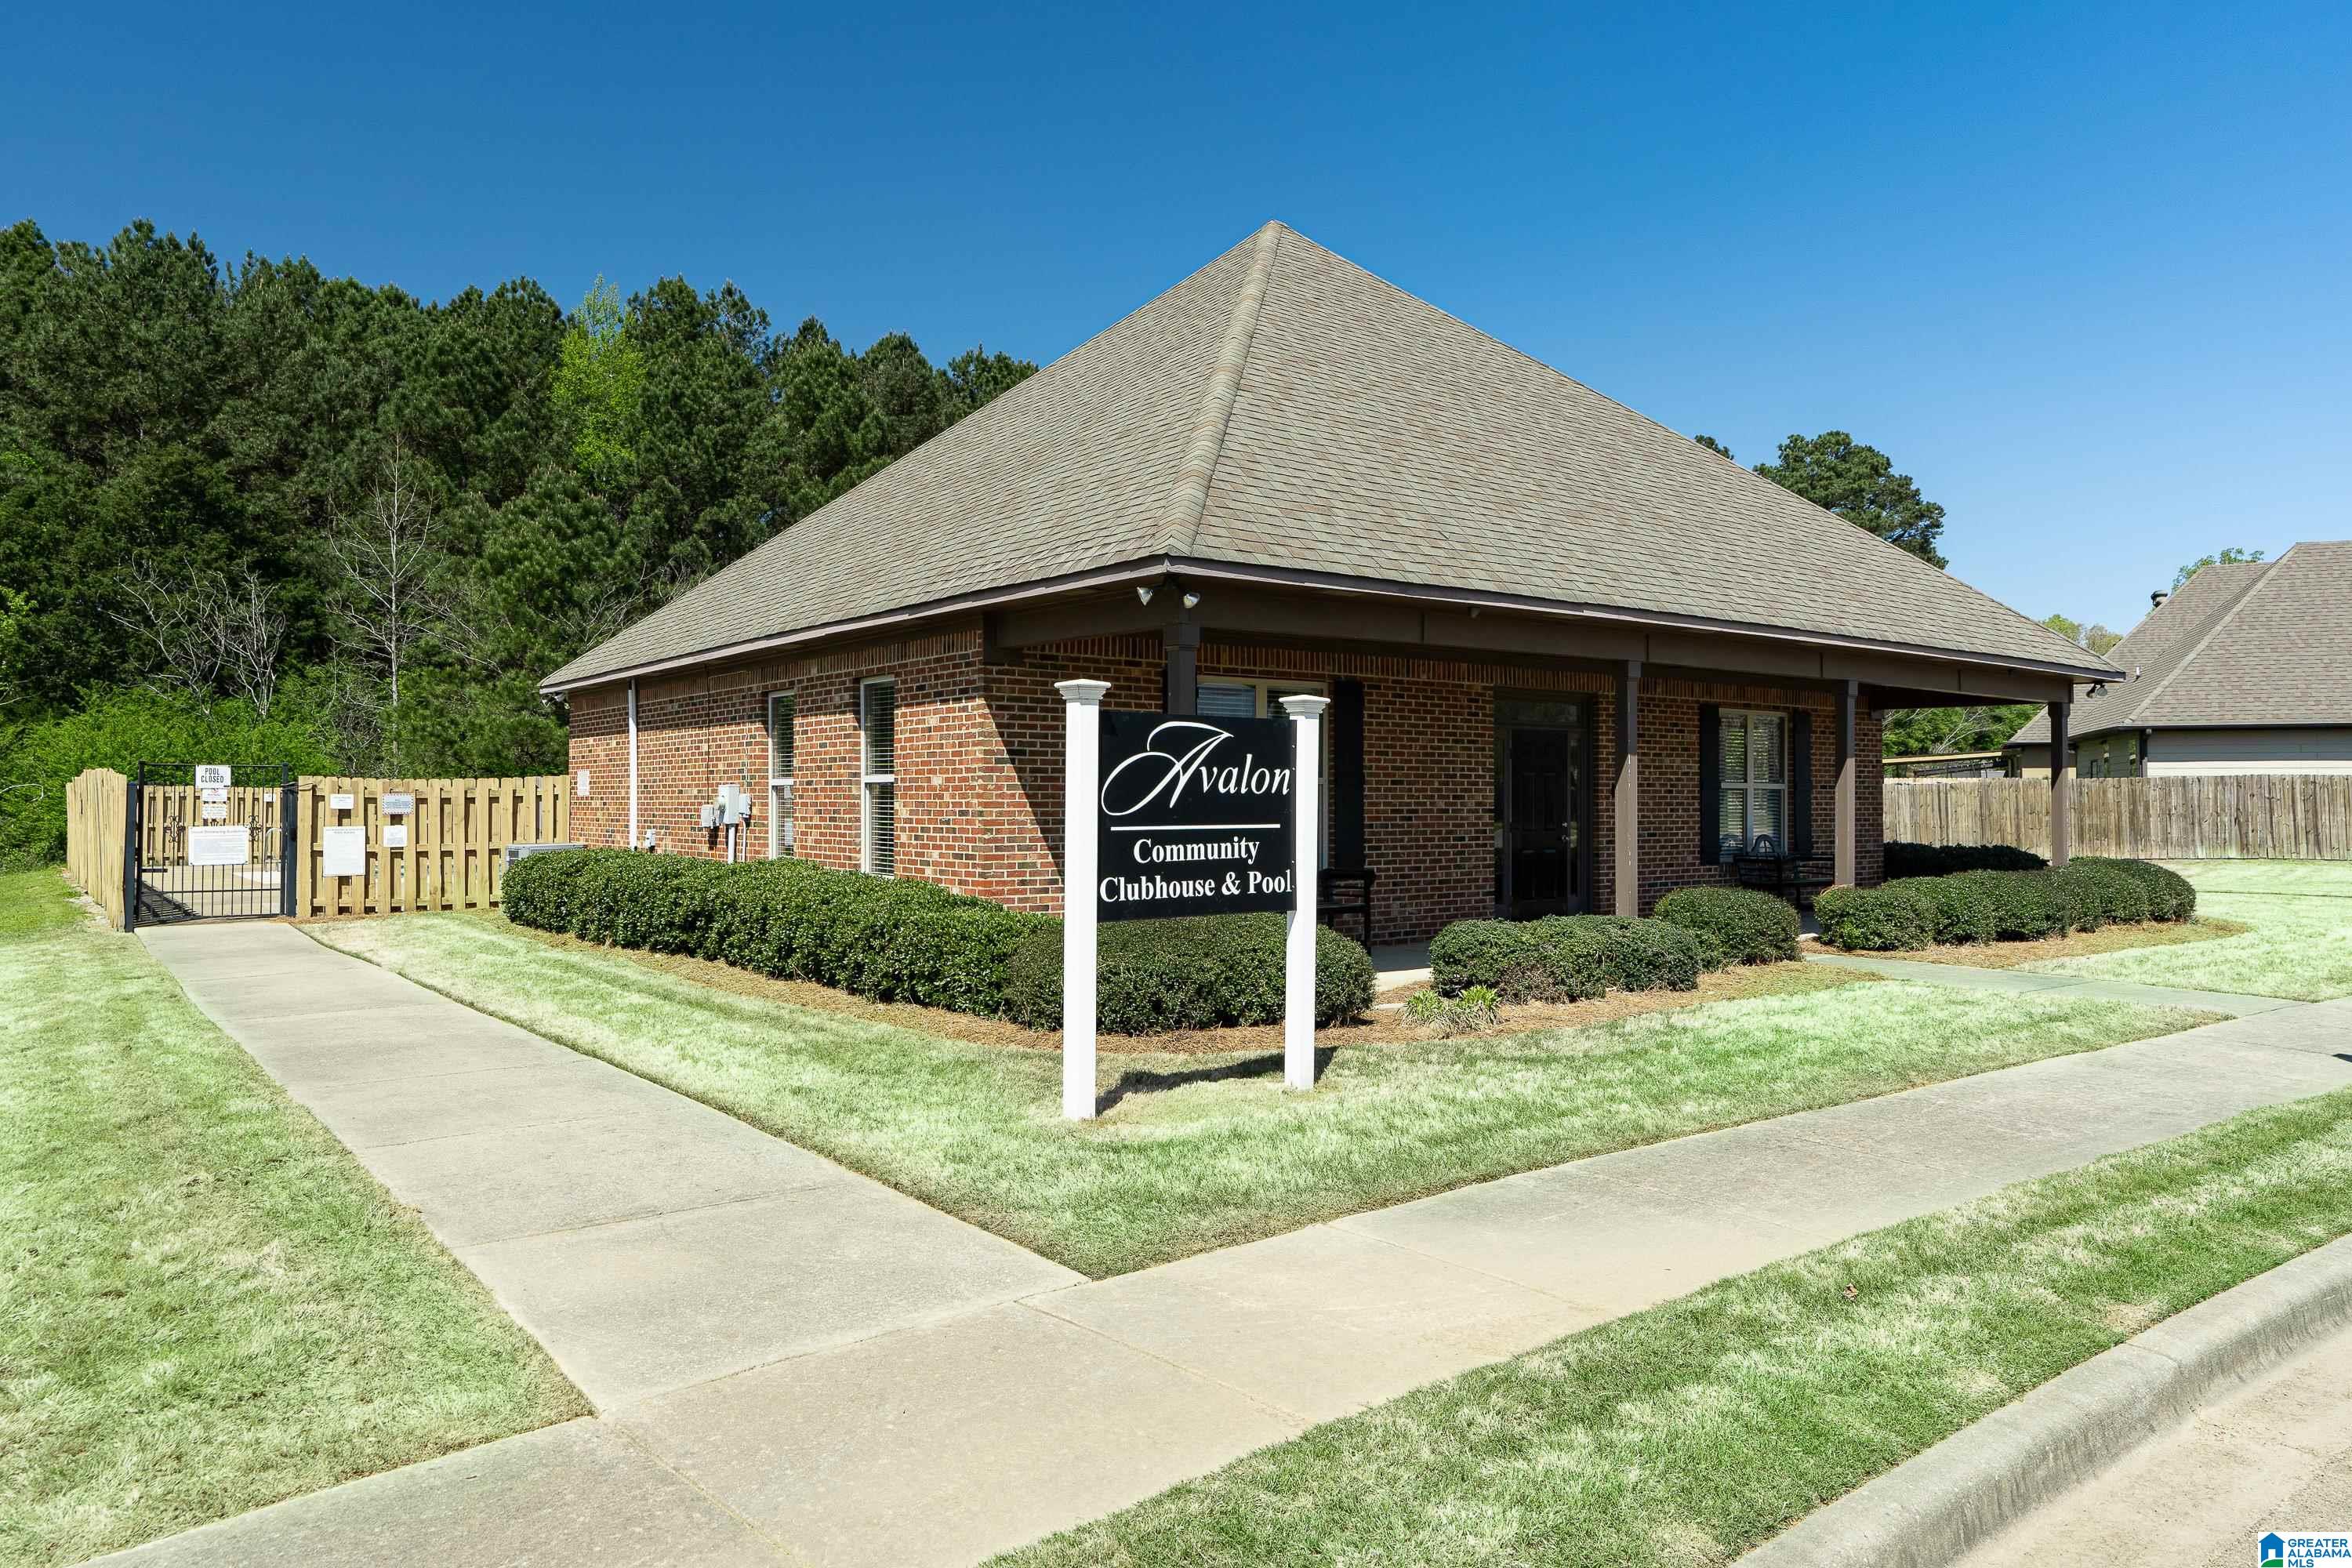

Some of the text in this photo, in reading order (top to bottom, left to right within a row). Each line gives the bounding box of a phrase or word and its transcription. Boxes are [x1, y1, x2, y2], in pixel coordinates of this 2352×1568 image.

[1101, 720, 1290, 816] Avalon
[1134, 837, 1260, 864] Community
[1099, 869, 1293, 902] Clubhouse & Pool
